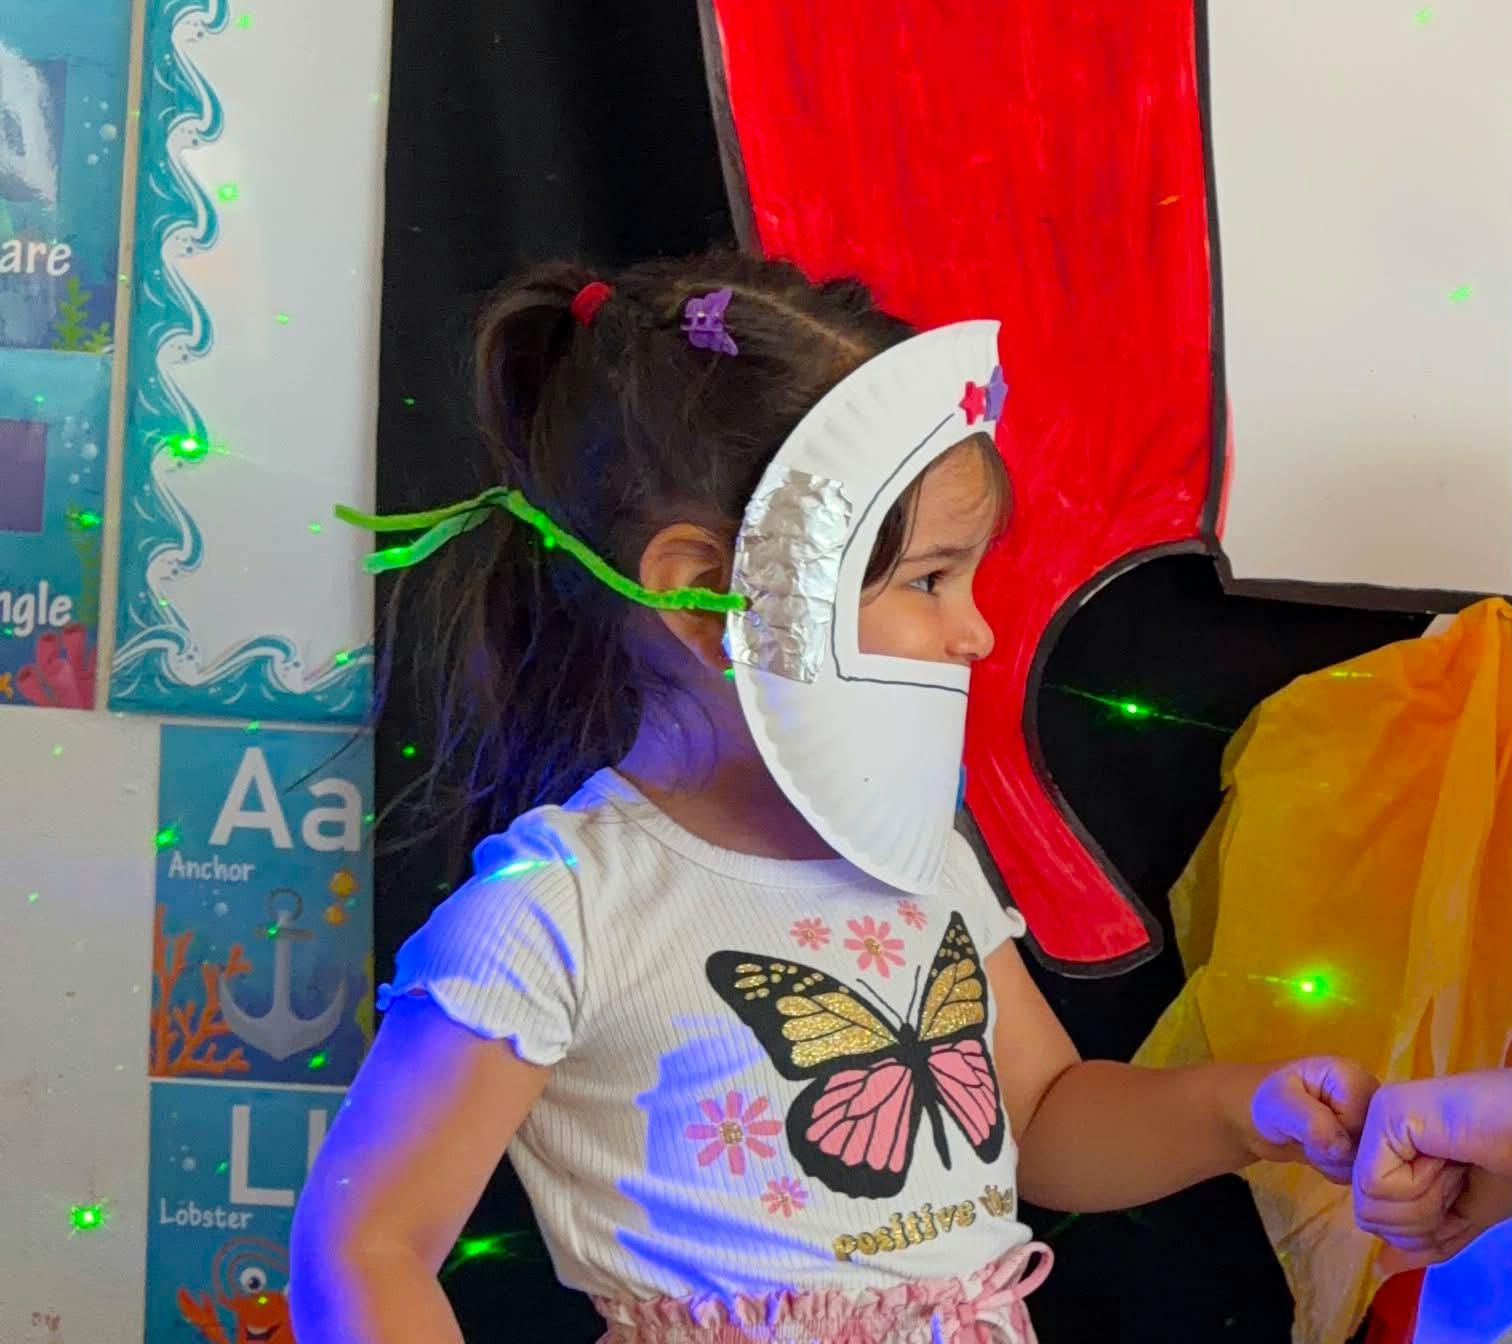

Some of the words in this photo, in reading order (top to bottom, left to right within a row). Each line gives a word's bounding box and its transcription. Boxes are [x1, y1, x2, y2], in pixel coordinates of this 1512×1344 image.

[208, 746, 362, 852] Aa
[167, 850, 255, 882] Anchor
[159, 1197, 254, 1230] Lobster
